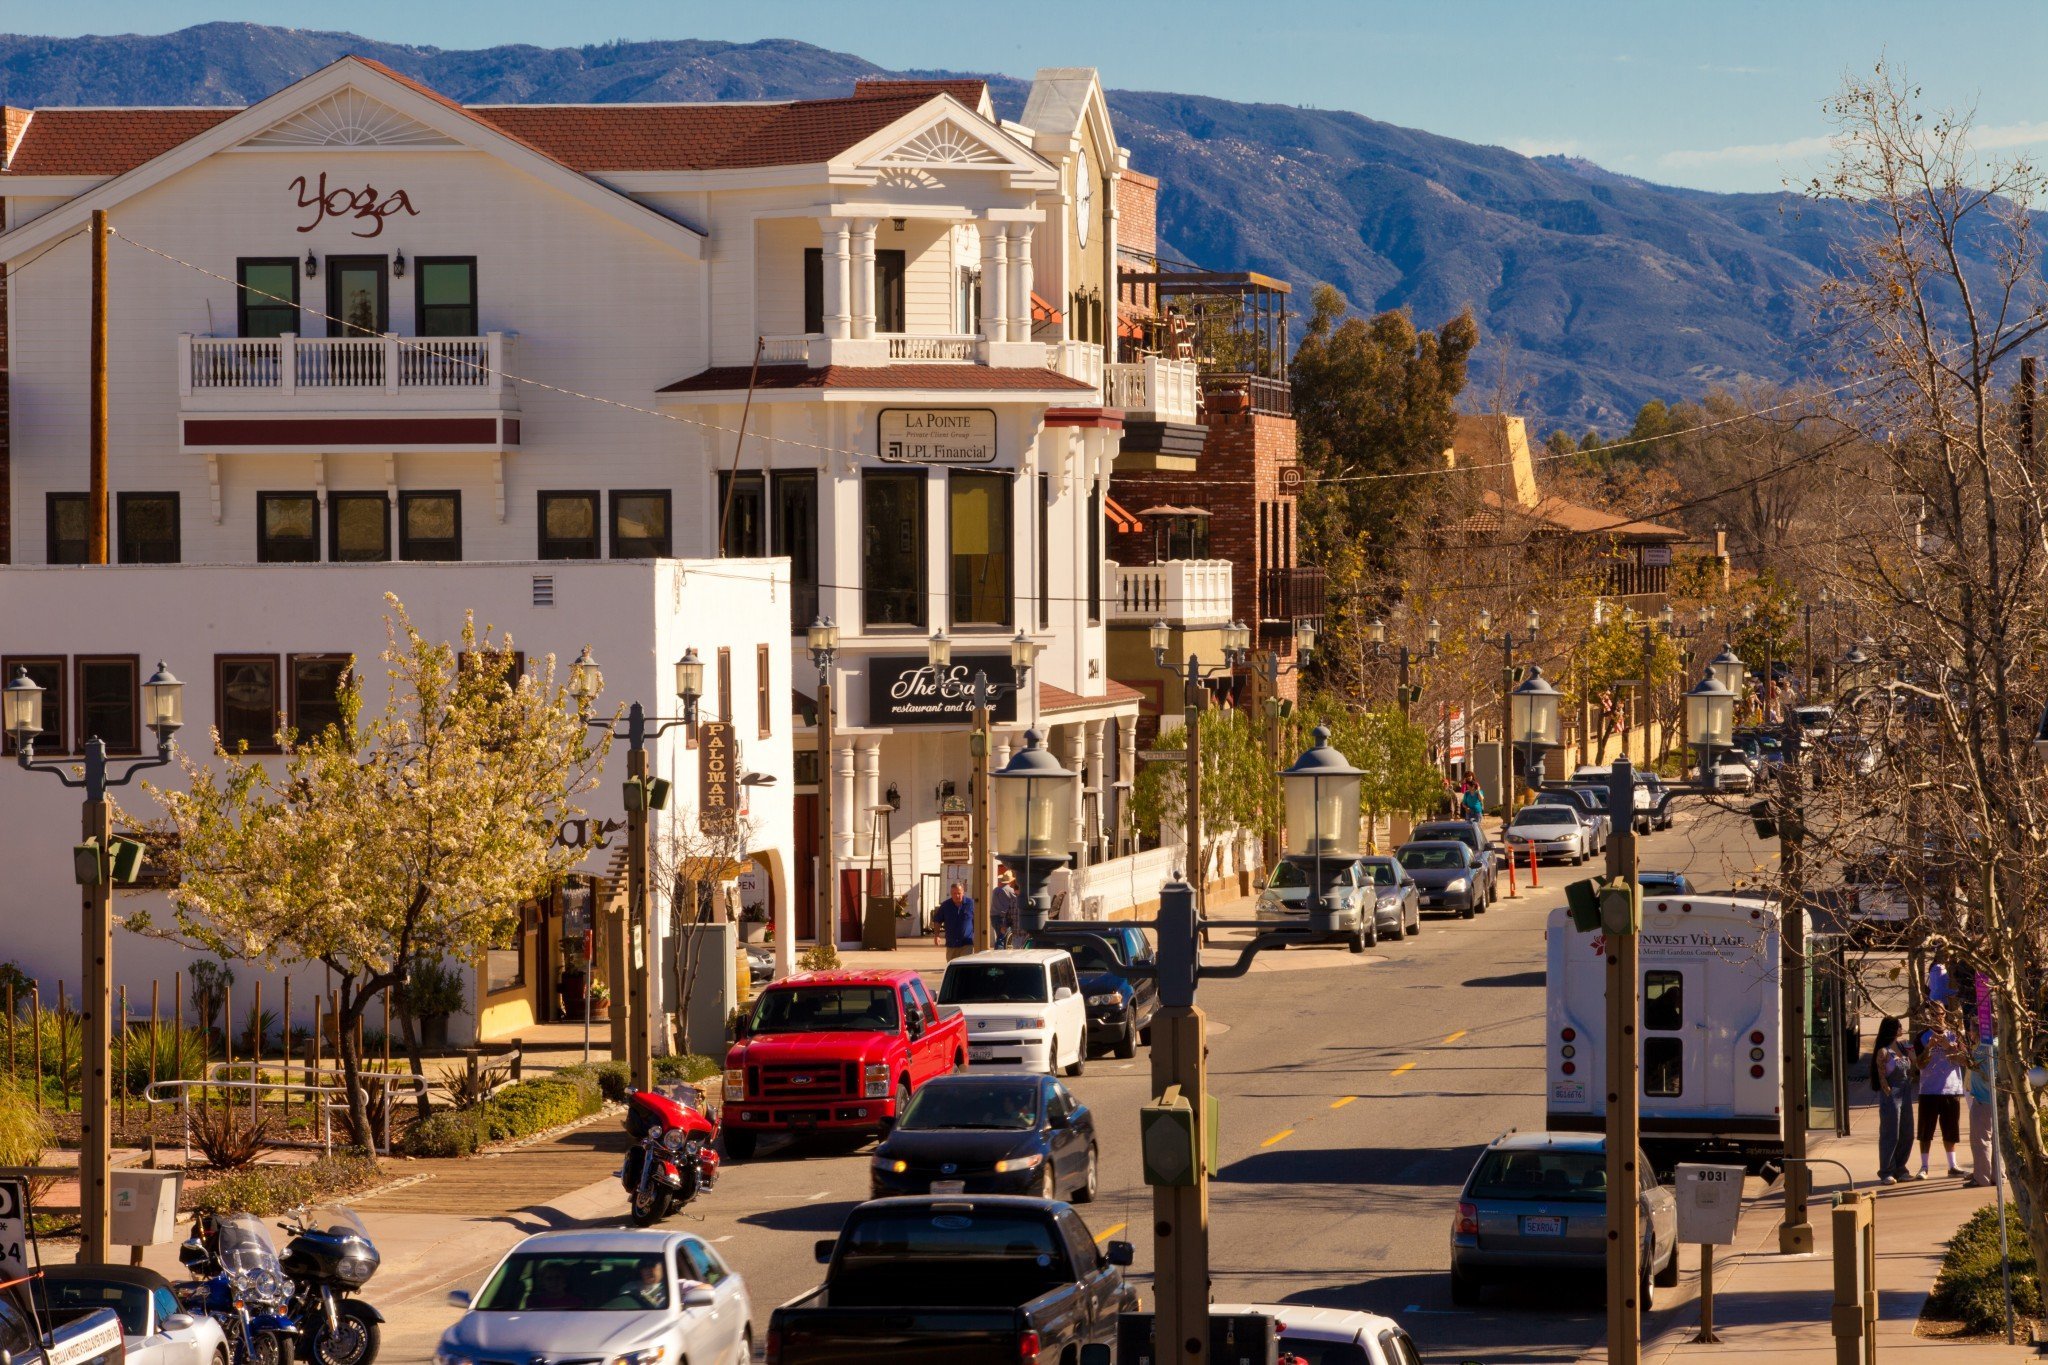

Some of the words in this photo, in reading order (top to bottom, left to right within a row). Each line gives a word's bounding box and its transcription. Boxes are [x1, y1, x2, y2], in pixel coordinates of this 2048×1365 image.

[288, 171, 420, 238] Yoga
[951, 431, 970, 439] Group
[906, 444, 931, 458] LPL
[934, 444, 986, 458] Financial
[891, 666, 937, 699] The
[892, 702, 943, 713] restaurant
[944, 702, 964, 712] and
[707, 724, 727, 806] PALOMAR
[1643, 947, 1666, 955] Merrill
[1667, 948, 1694, 956] Gardens
[1699, 1170, 1727, 1182] 9031
